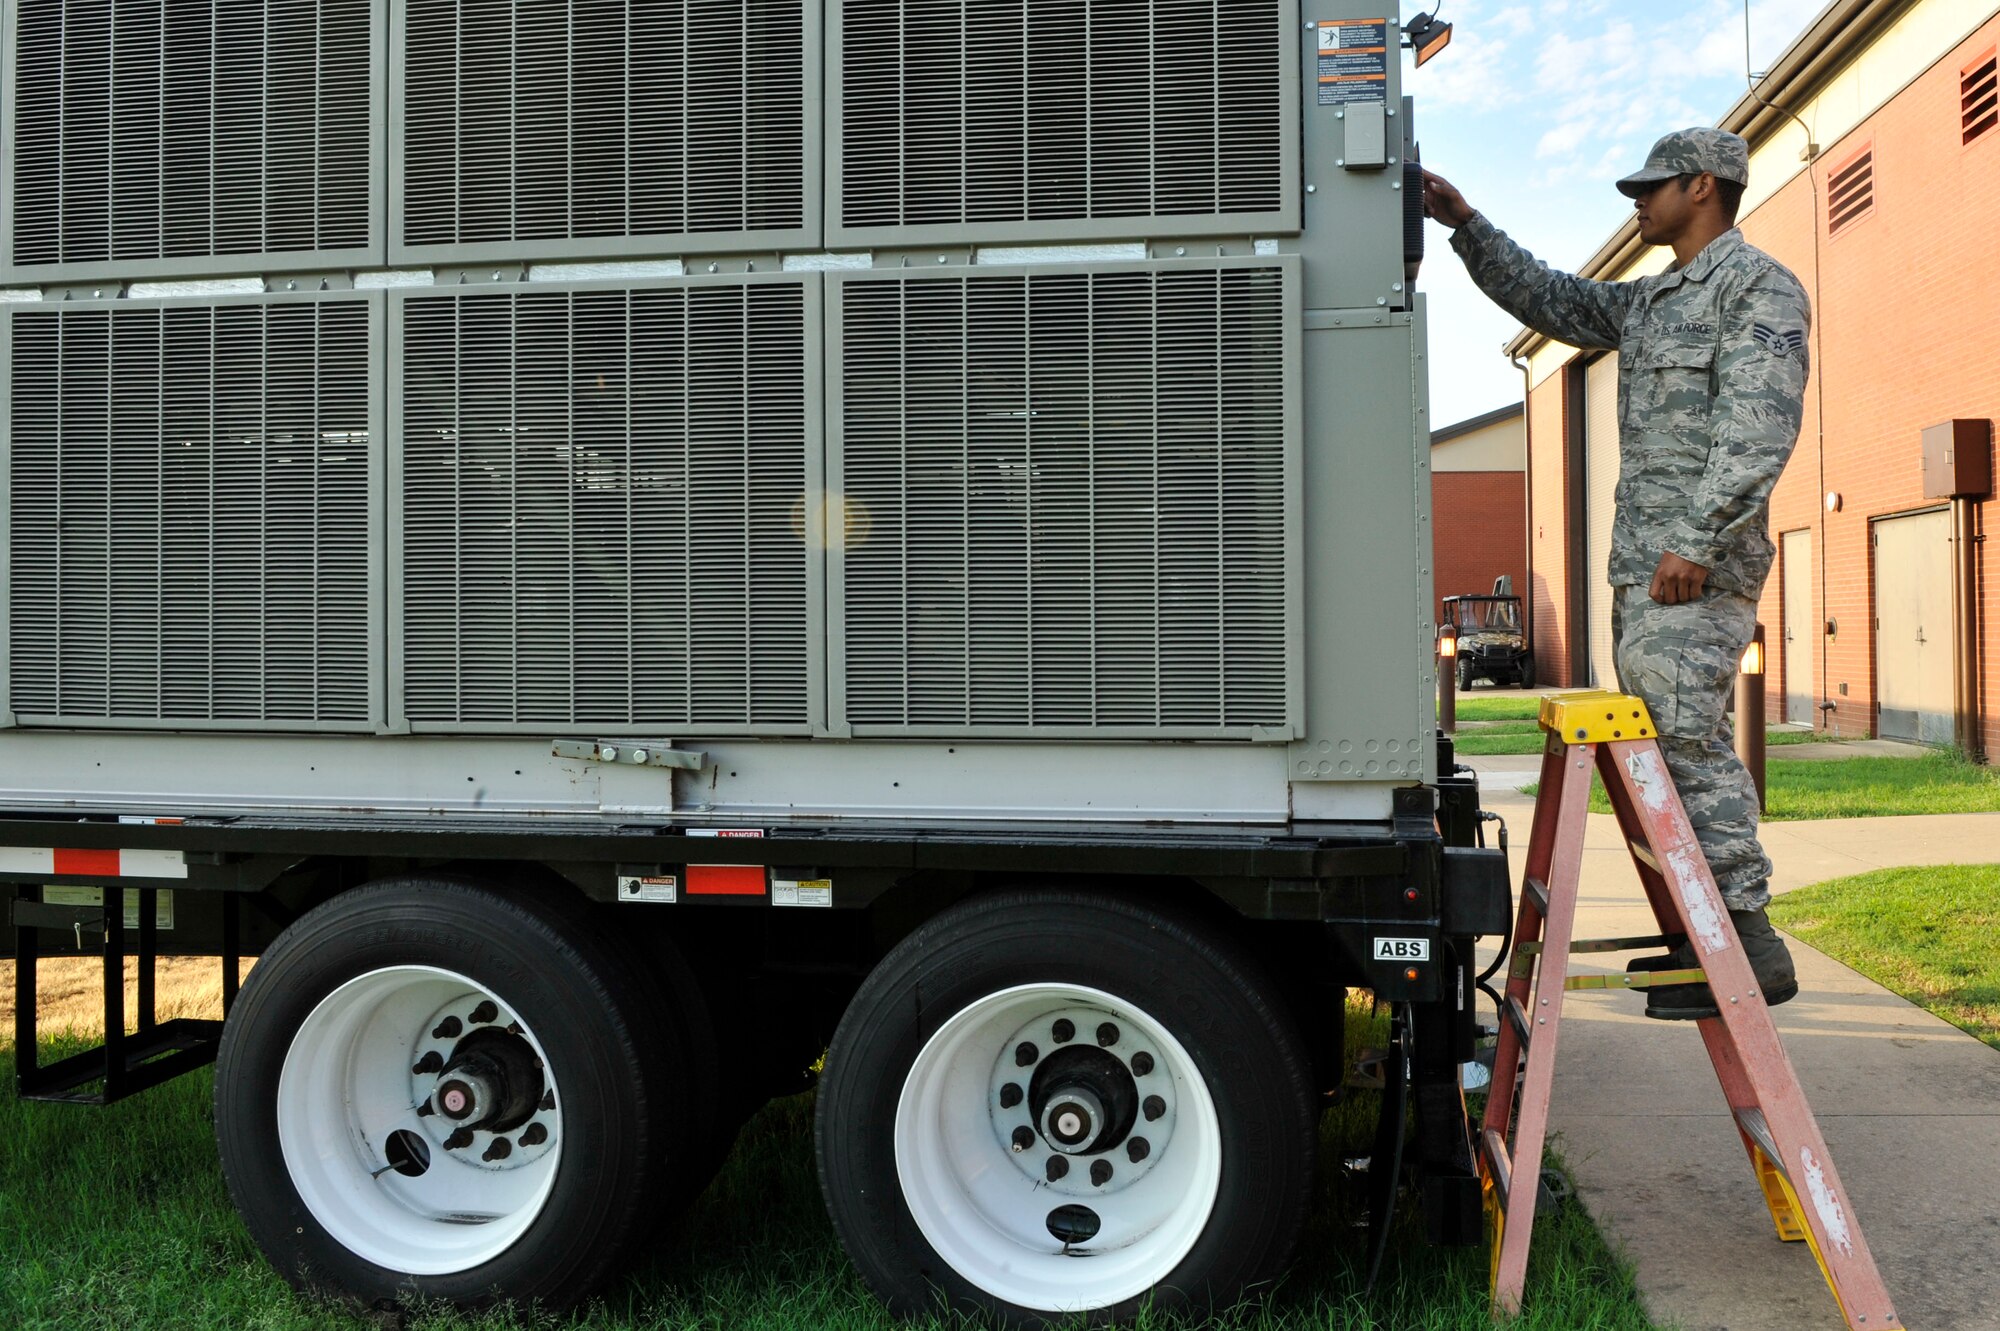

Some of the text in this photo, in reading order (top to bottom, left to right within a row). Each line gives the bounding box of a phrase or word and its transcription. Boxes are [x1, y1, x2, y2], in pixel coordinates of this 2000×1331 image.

[1672, 324, 1683, 334] AIR
[1683, 322, 1712, 334] FORCE
[1380, 941, 1422, 957] ABS
